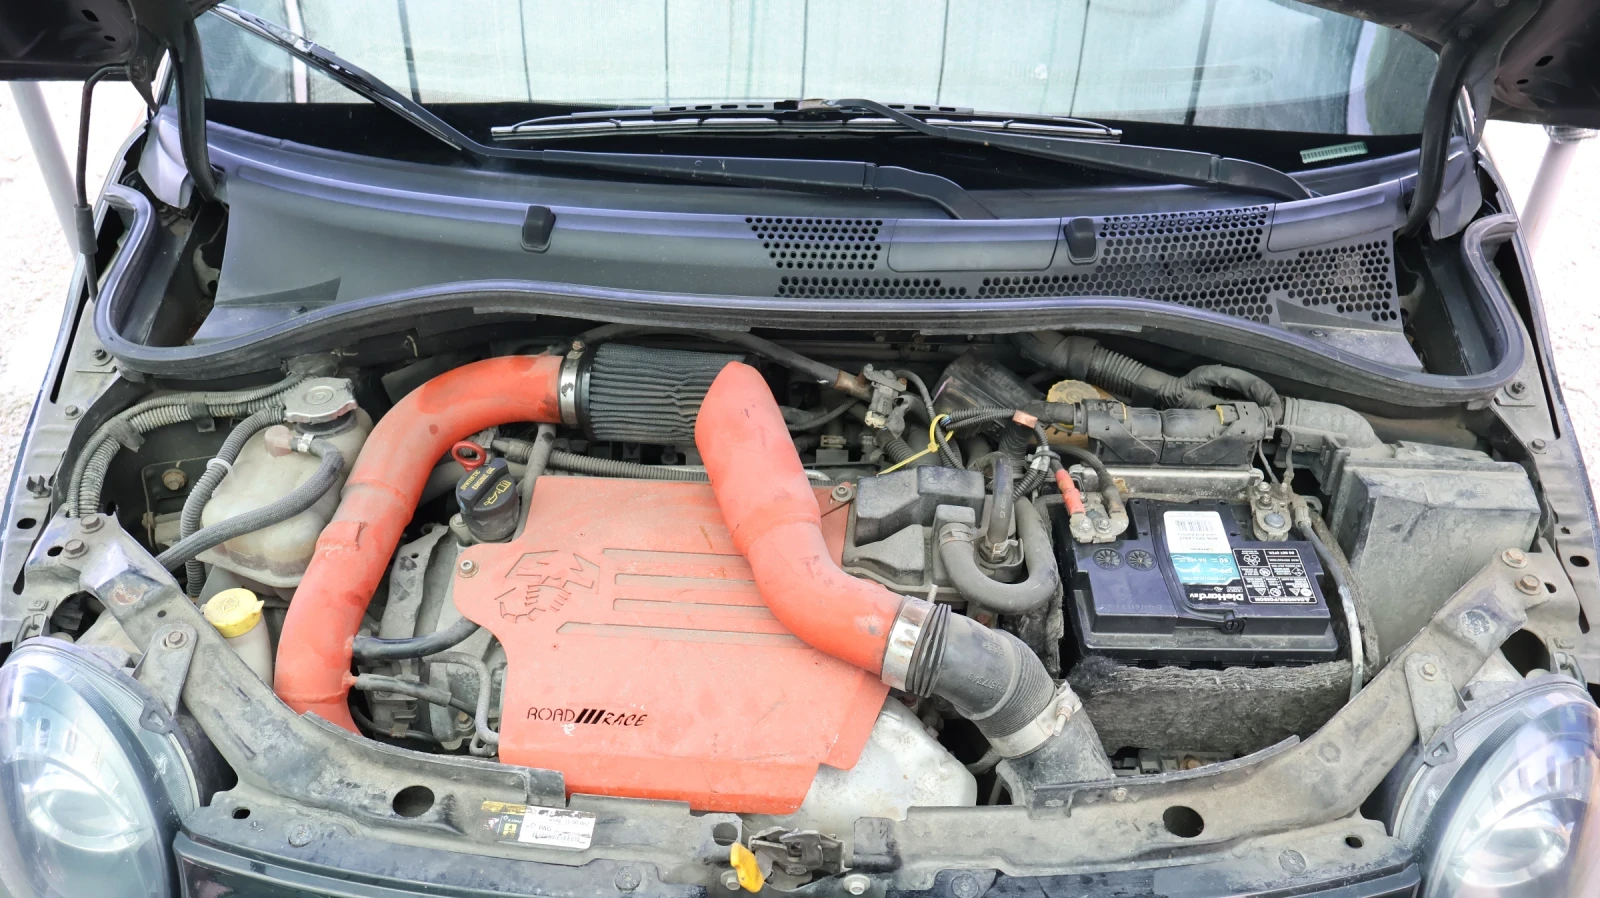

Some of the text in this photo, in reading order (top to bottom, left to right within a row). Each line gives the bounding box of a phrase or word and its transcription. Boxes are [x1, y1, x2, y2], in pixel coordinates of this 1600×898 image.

[472, 467, 496, 490] ENGINE OIL
[1198, 593, 1244, 601] DieHard
[527, 706, 648, 727] ROAD RACE
